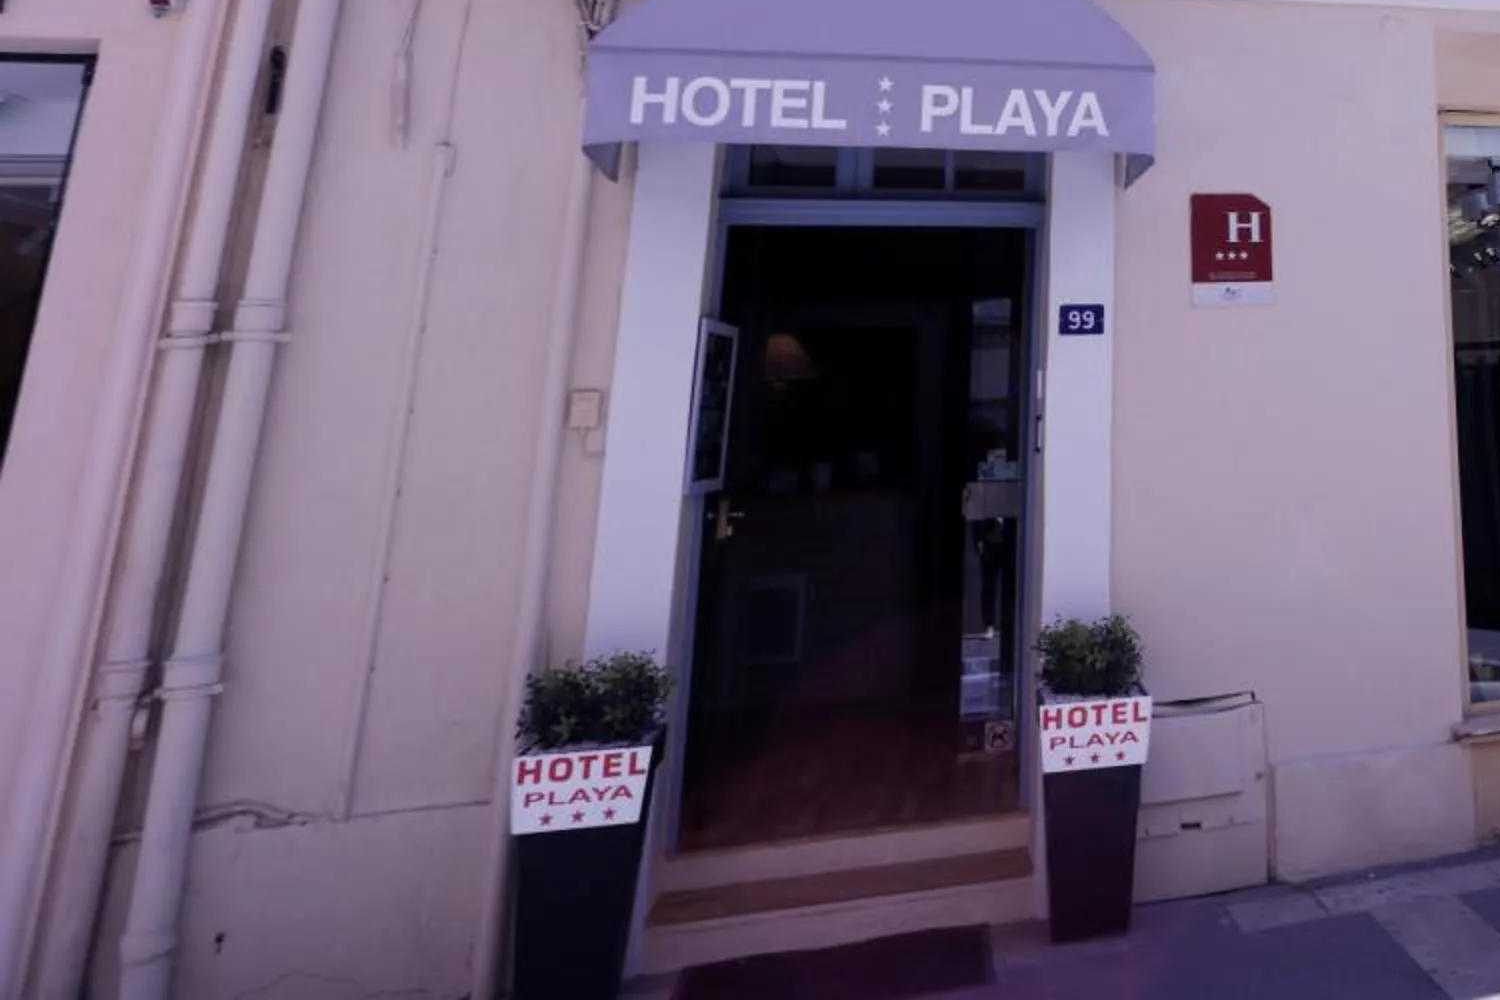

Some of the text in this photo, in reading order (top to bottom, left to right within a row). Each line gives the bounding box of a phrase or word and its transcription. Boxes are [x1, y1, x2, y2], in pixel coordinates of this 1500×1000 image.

[628, 75, 1109, 138] HOTEL PLAYA
[1224, 211, 1264, 243] H
[1069, 310, 1095, 329] 99
[1043, 701, 1148, 730] HOTEL
[1050, 731, 1138, 750] PLAYA
[517, 752, 646, 784] HOTEL
[523, 784, 633, 808] PLAYA
